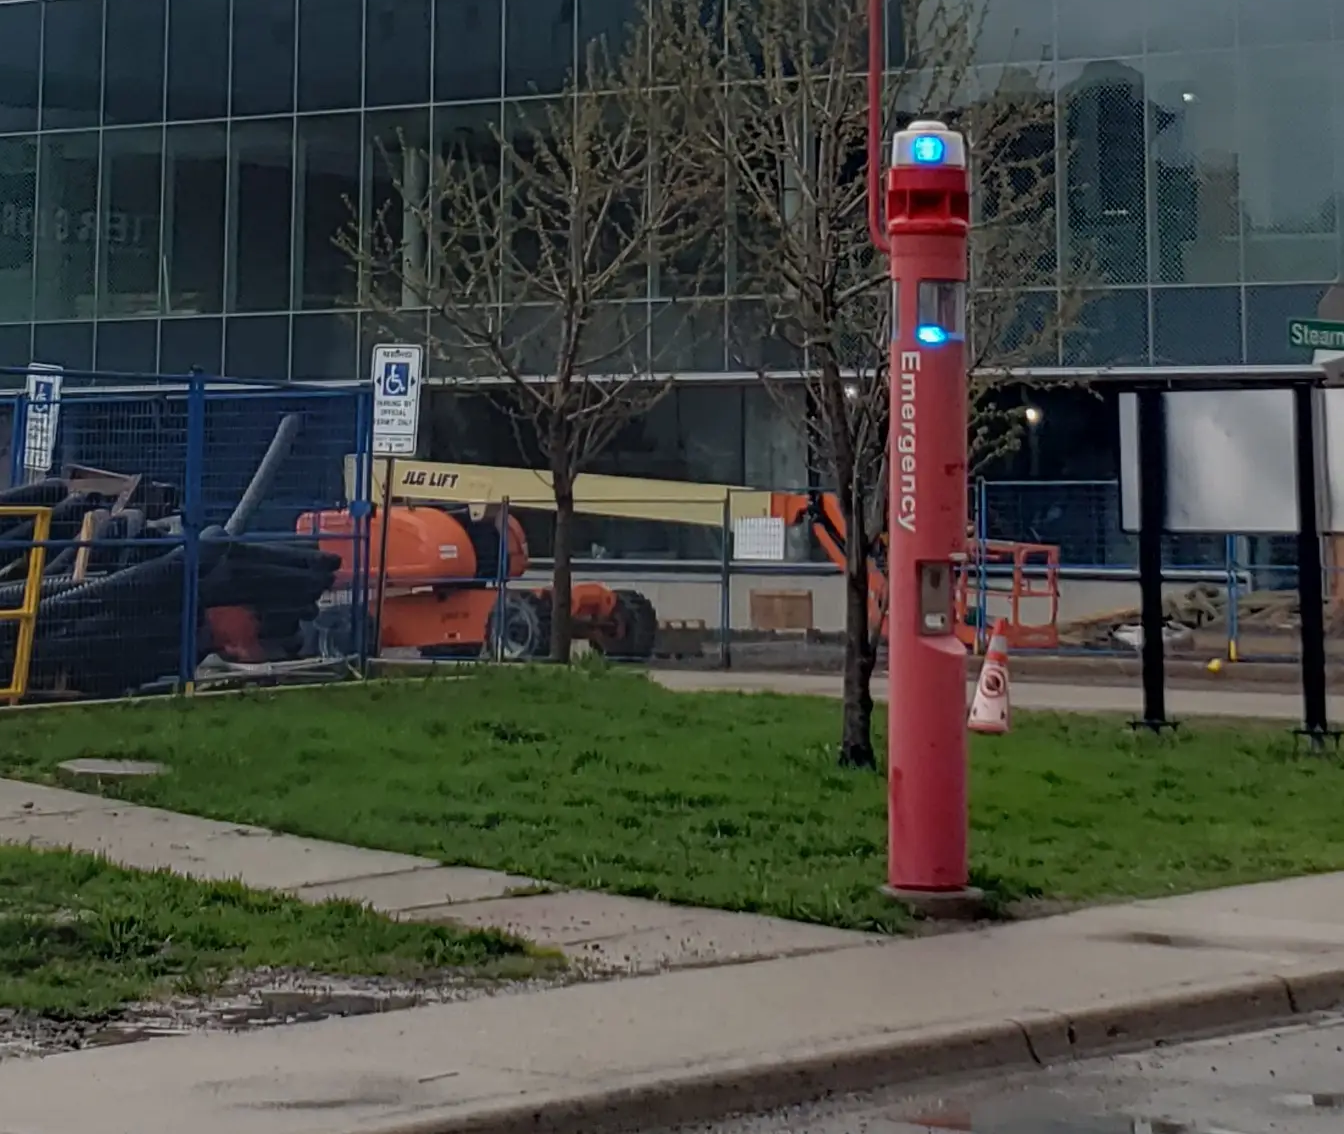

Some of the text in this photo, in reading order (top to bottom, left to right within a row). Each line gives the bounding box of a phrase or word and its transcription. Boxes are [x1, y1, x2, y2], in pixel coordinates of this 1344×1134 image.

[402, 470, 459, 488] JLG LIFT
[897, 350, 921, 533] Emergency
